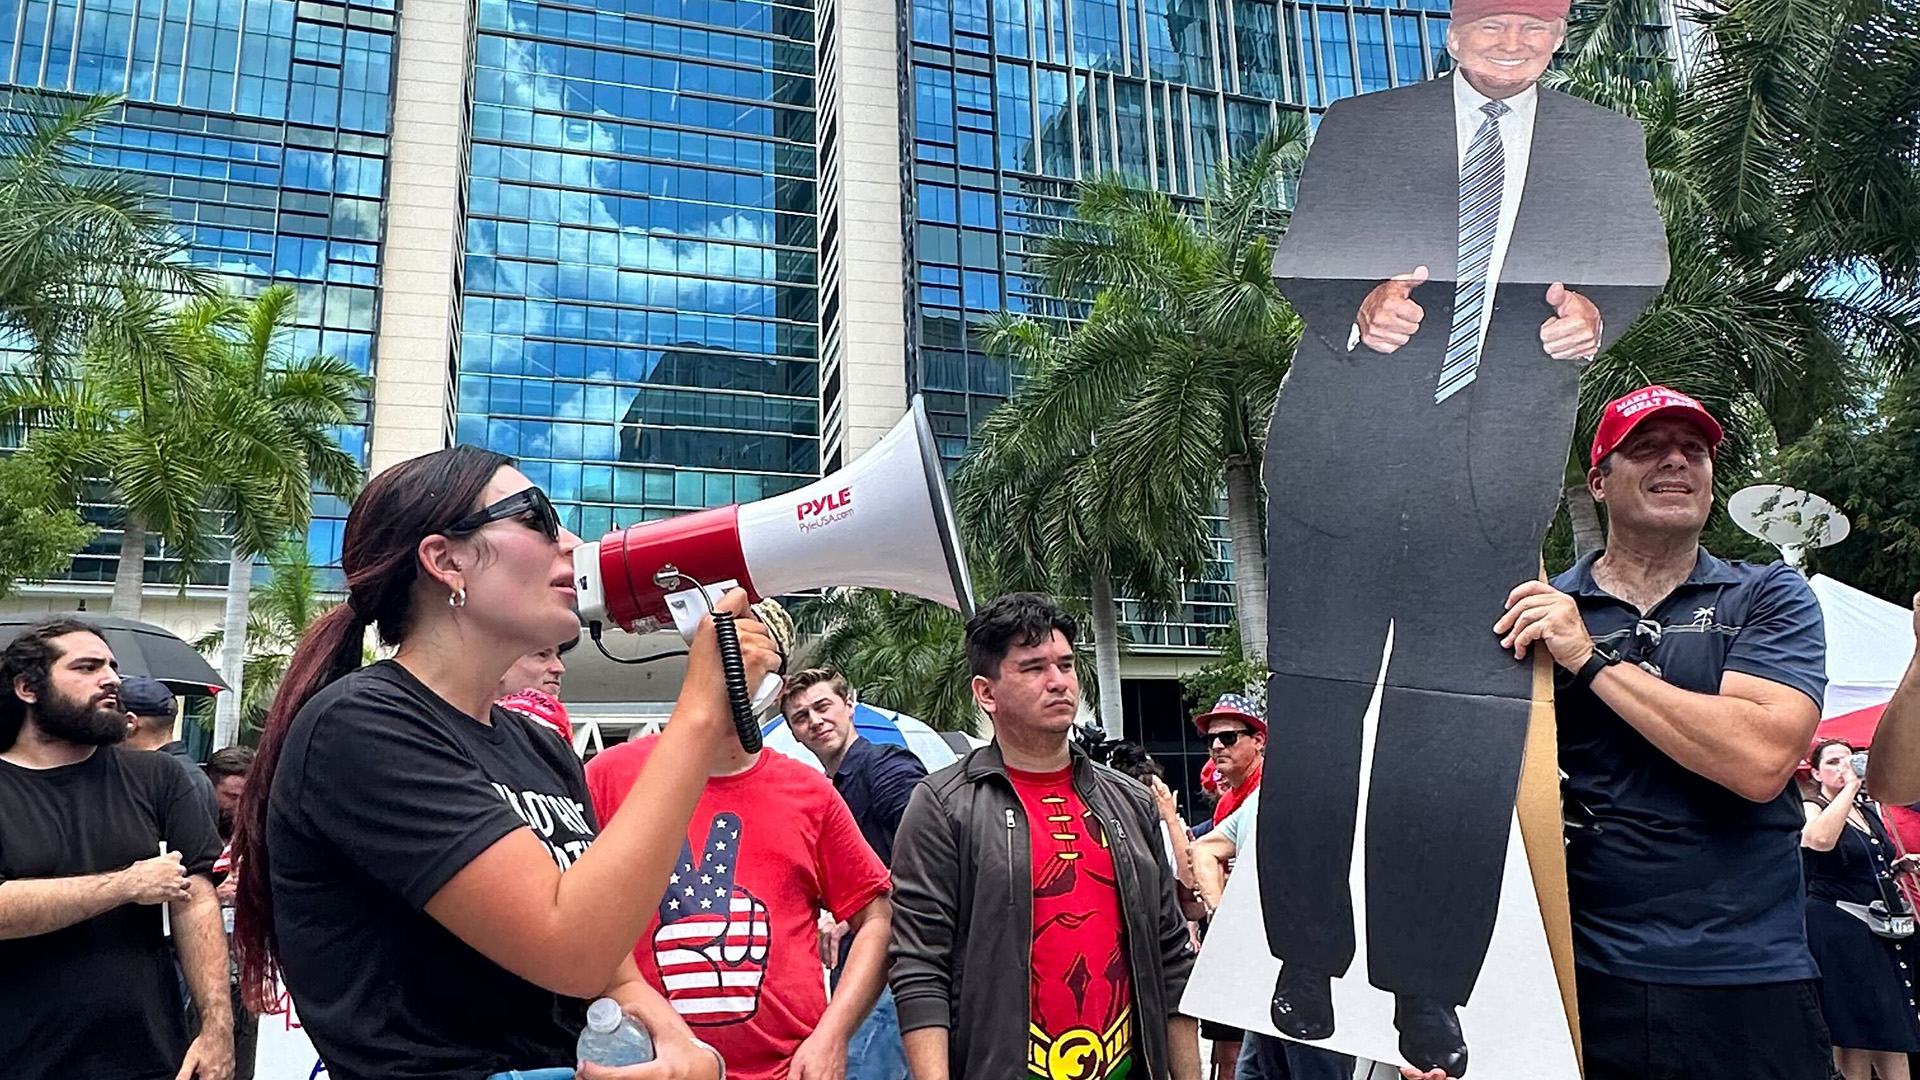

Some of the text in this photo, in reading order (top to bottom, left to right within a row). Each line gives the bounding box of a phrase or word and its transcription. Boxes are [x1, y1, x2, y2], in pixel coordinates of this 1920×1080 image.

[1623, 398, 1661, 417] GREAT
[797, 487, 852, 520] PYLE
[799, 508, 855, 534] PyleUSA.com
